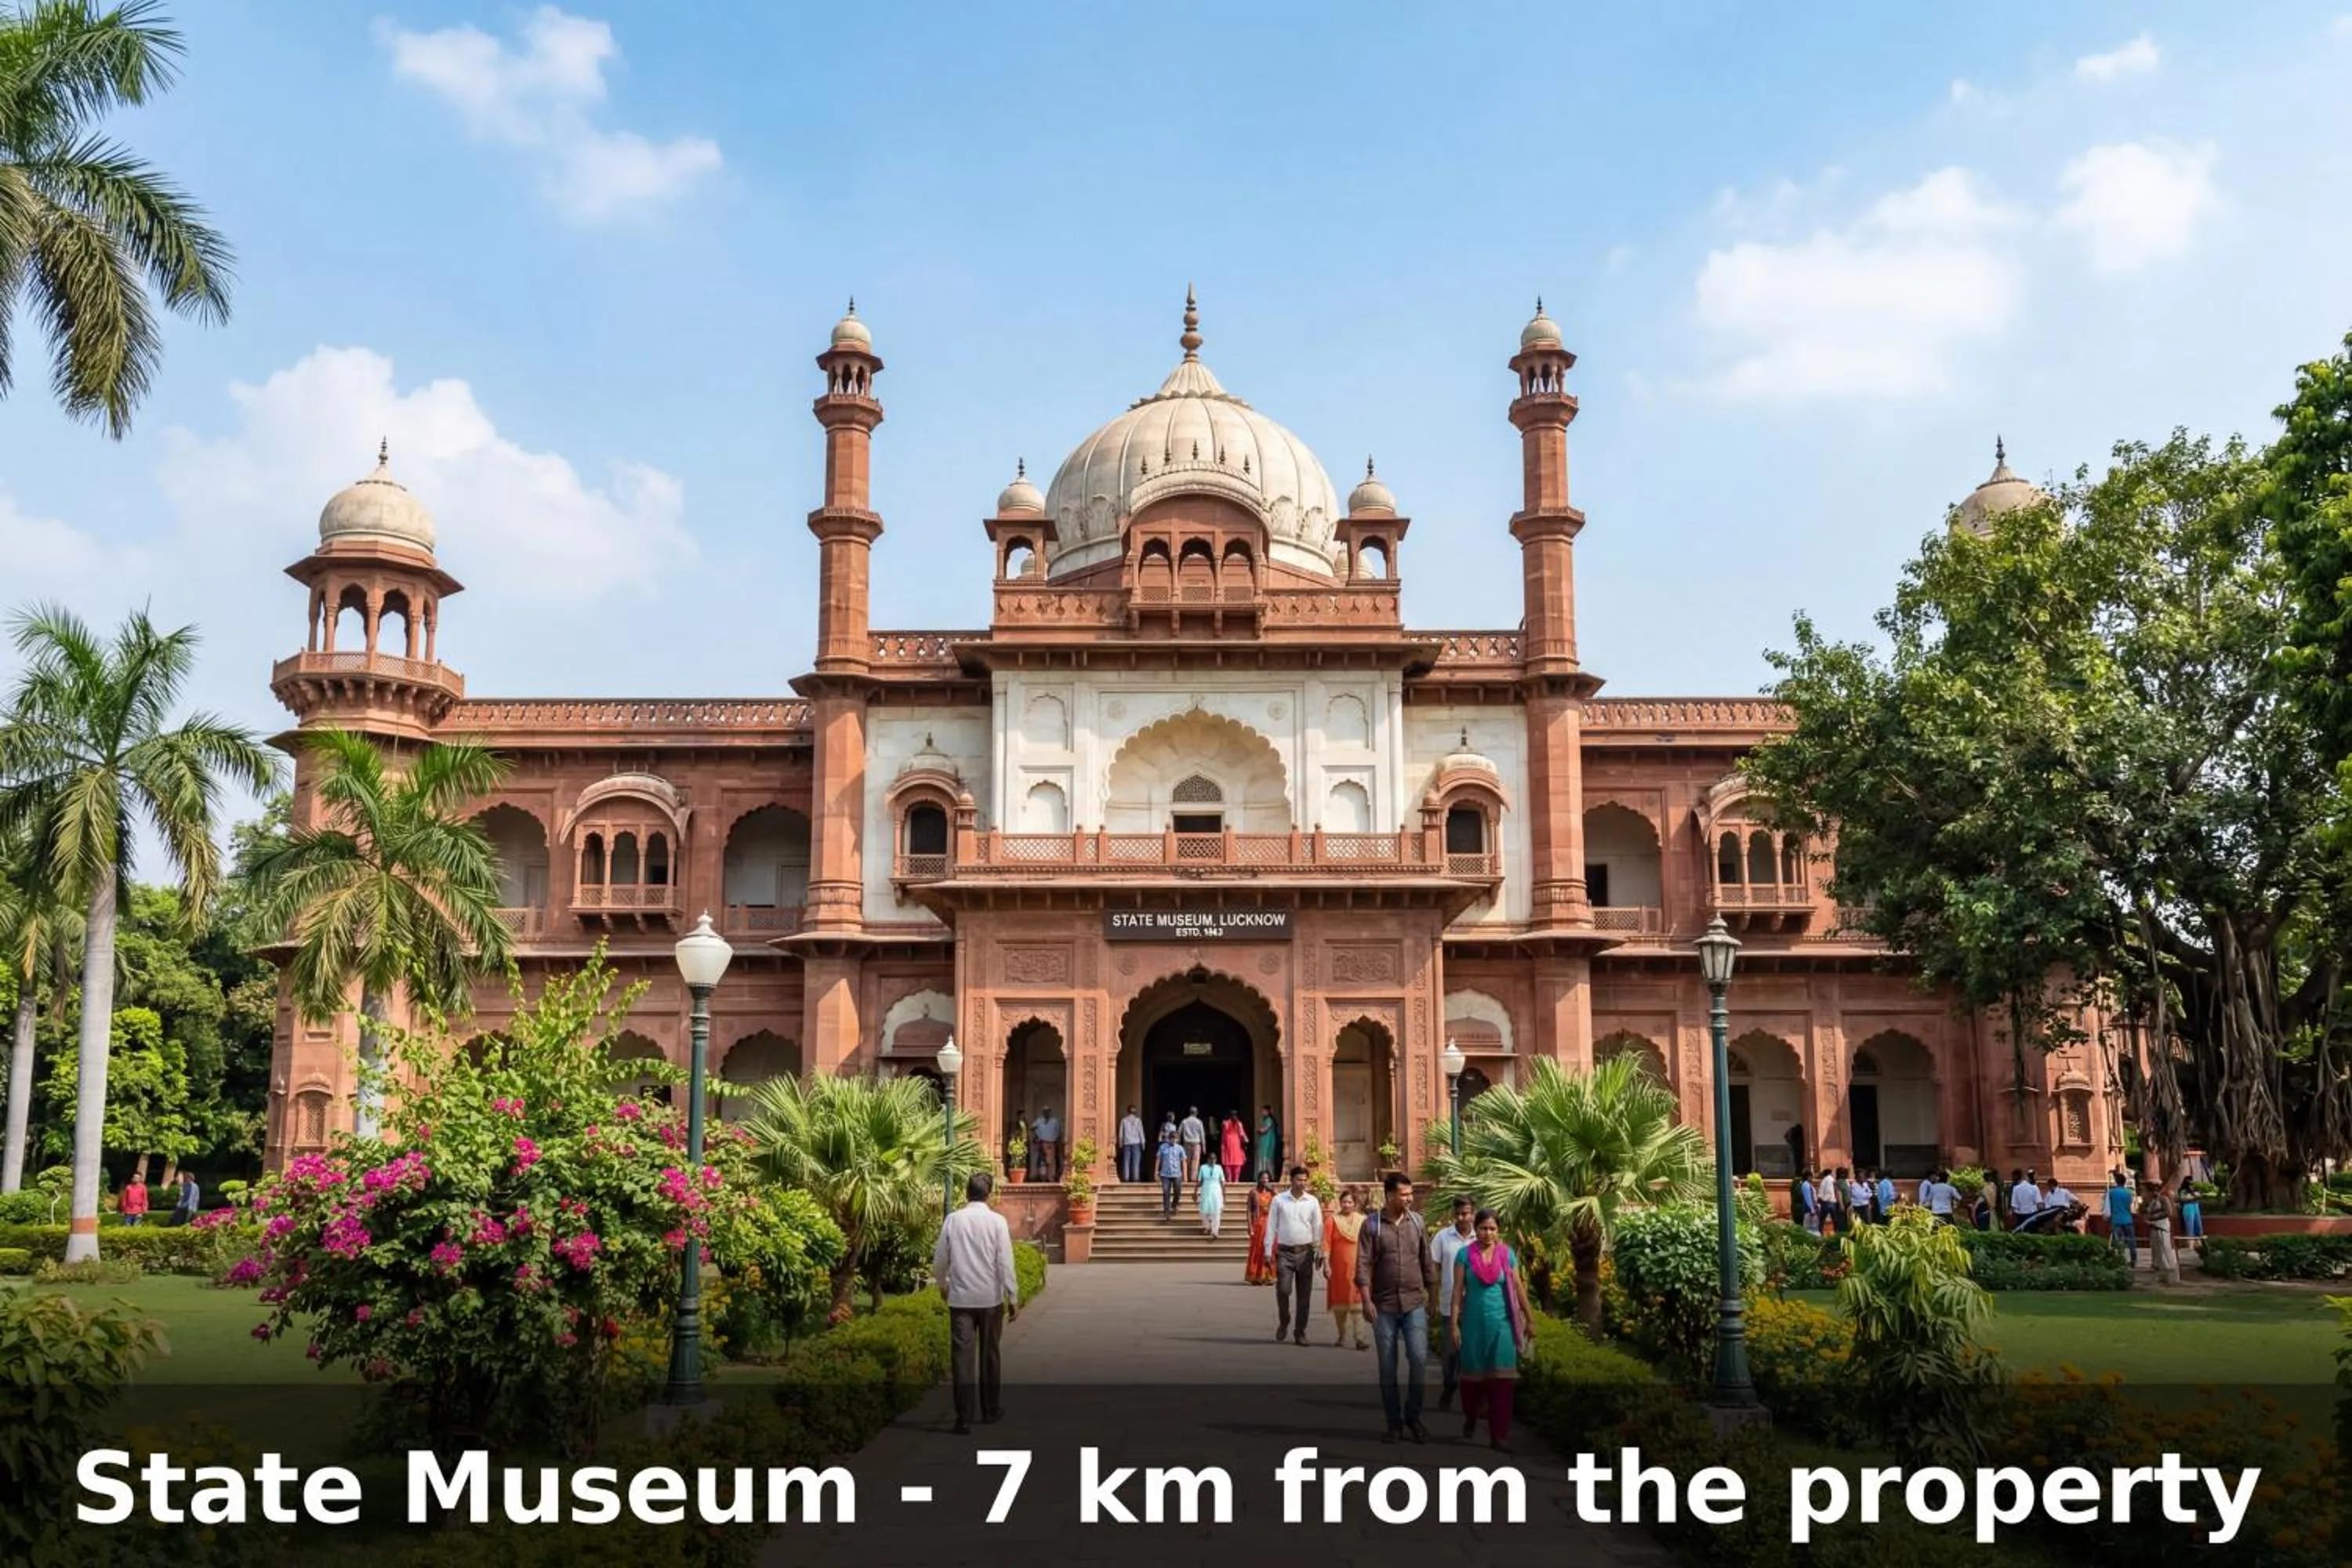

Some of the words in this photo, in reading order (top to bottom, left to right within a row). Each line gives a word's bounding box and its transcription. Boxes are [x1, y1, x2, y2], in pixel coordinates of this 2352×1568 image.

[1112, 914, 1153, 927] STATE
[1156, 914, 1216, 927] MUSEUM,
[1219, 914, 1286, 927] LUCKNOW
[1175, 927, 1202, 937] ESTD.
